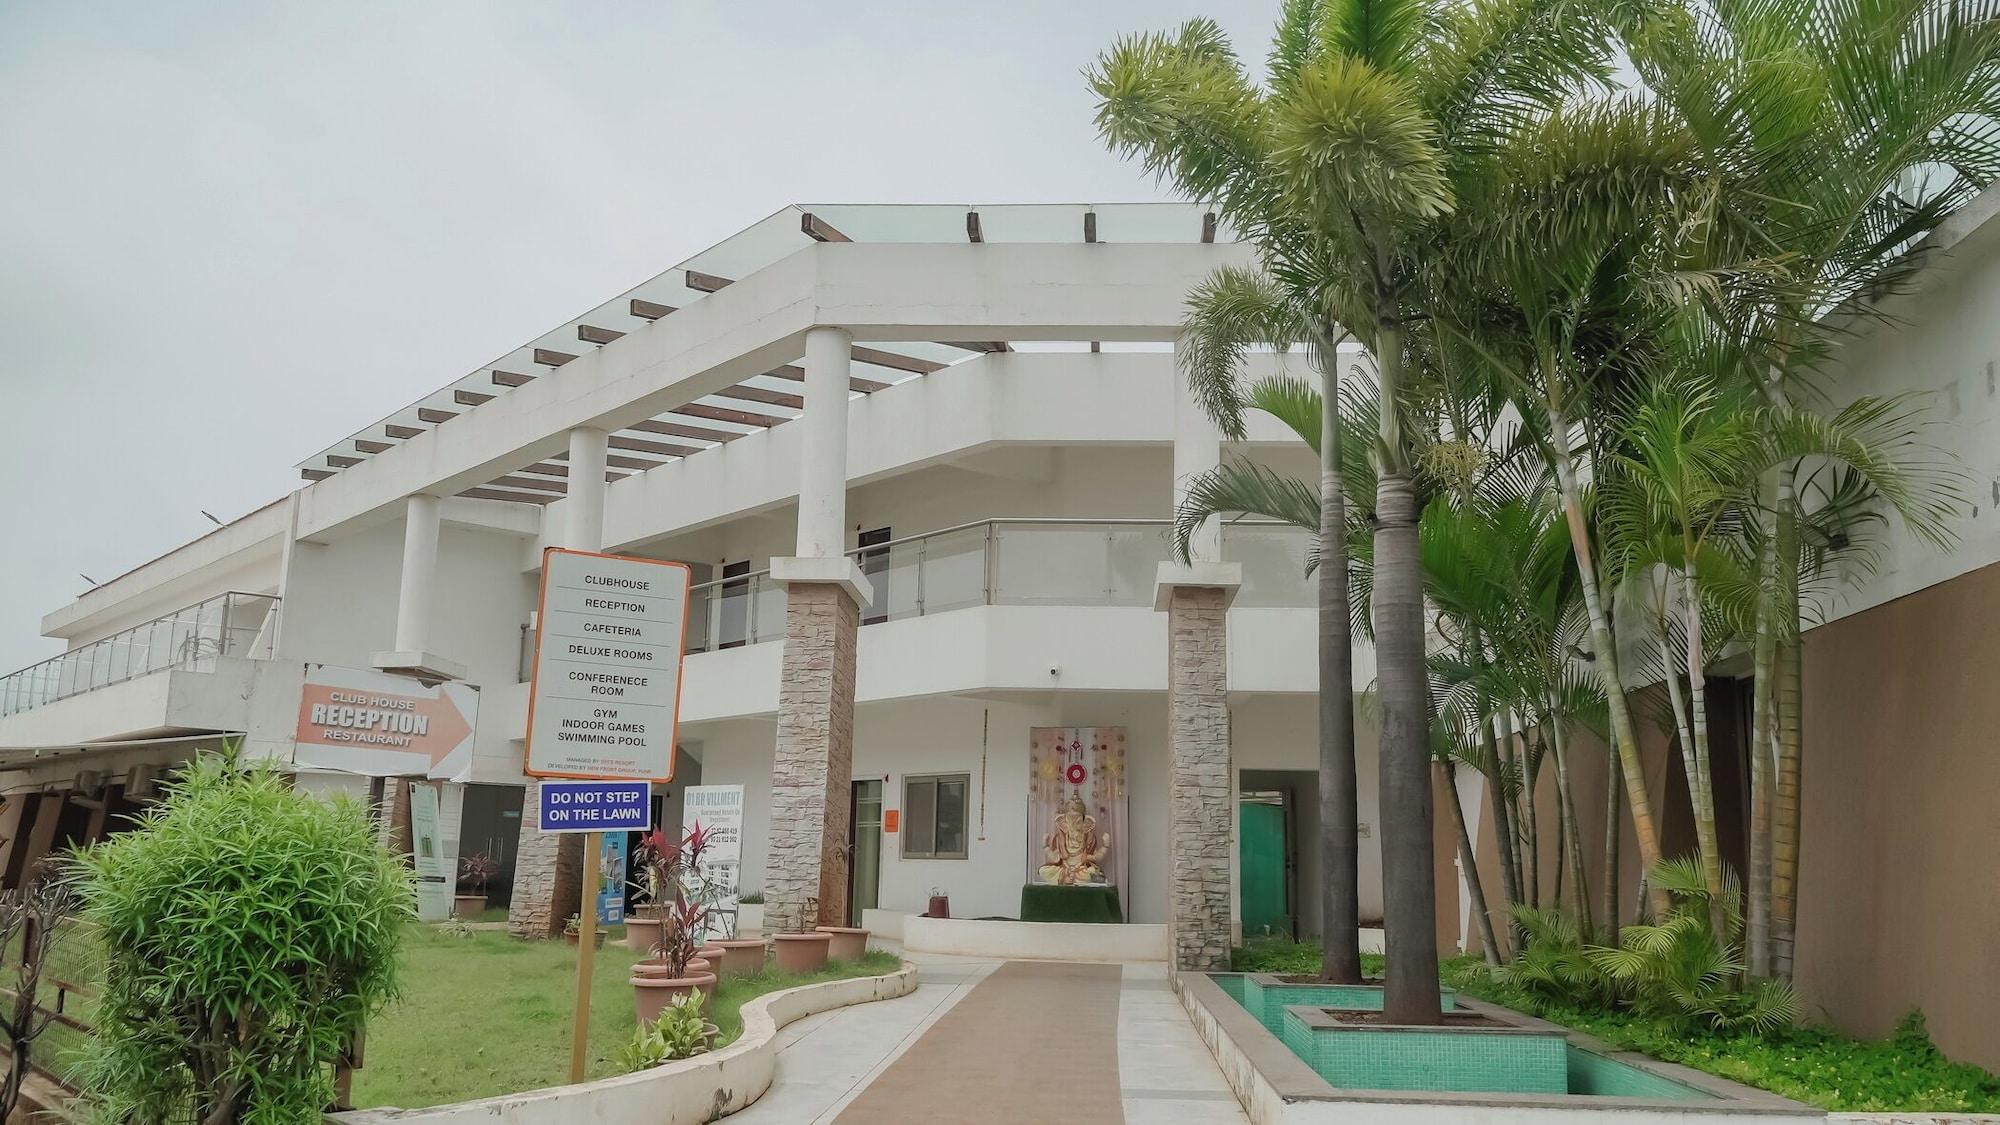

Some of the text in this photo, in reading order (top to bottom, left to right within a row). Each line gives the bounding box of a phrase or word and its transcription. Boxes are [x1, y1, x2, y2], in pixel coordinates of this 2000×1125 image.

[585, 575, 650, 590] CLUBHOUSE
[585, 599, 645, 613] RECEPTION
[584, 623, 641, 637] CAFETERIA
[568, 645, 653, 661] DELUXE ROOMS
[569, 672, 648, 686] CONFERENECE
[591, 686, 624, 696] ROOM
[330, 691, 416, 711] CLUB HOUSE
[311, 703, 428, 736] RECEPTION
[594, 708, 618, 719] GYM
[562, 719, 645, 733] INDOOR GAMES
[323, 729, 412, 747] RESTAURANT
[558, 732, 647, 747] SWIMMING POOL
[551, 791, 640, 804] DO NOT STEP
[549, 808, 640, 821] ON THE LAWN
